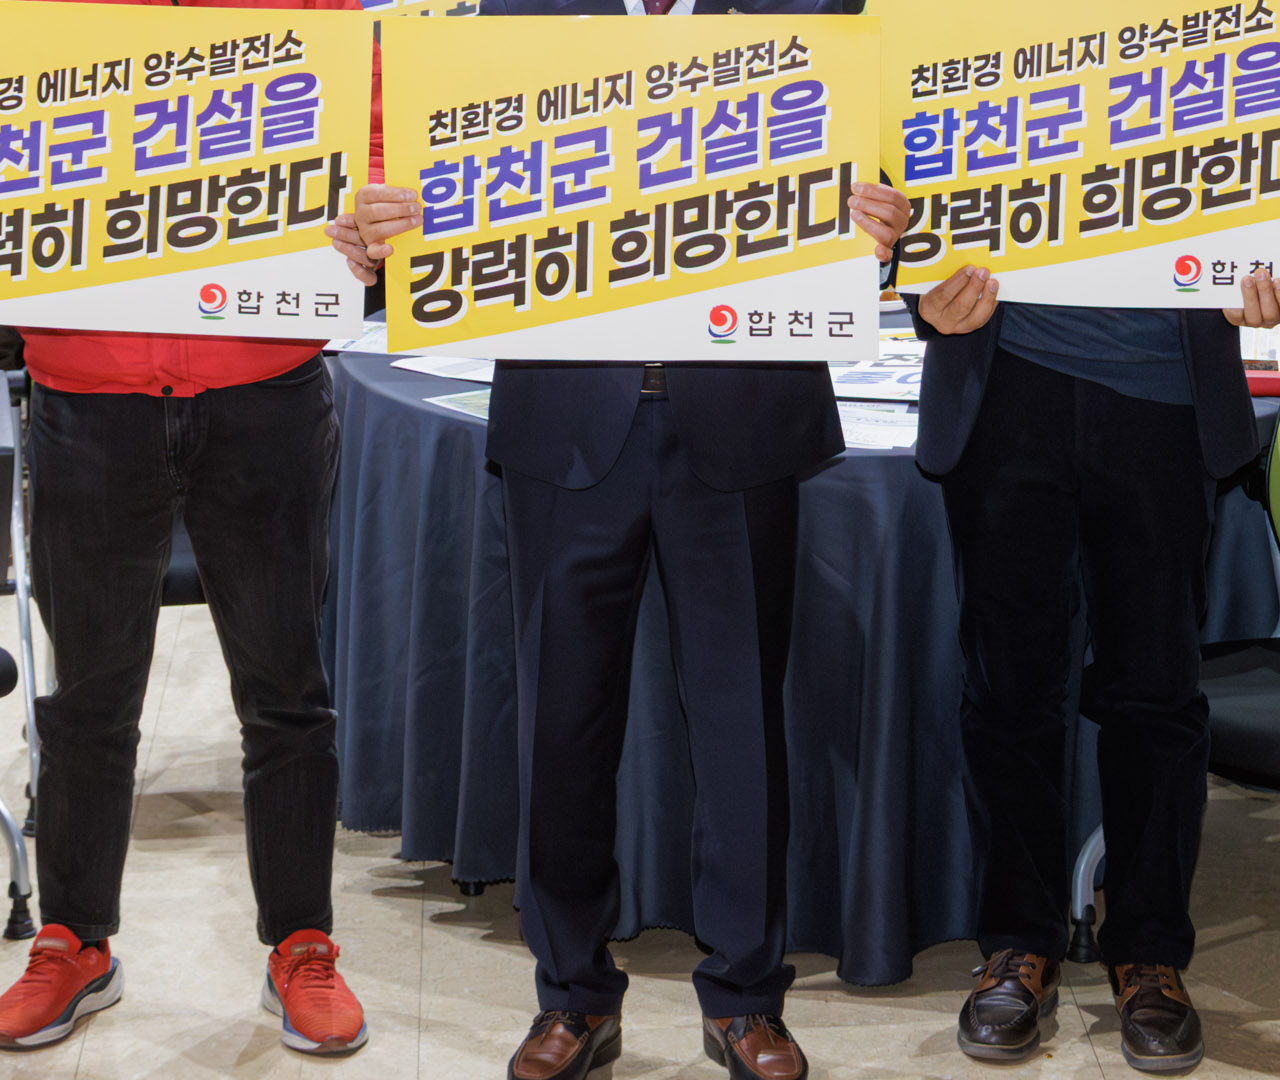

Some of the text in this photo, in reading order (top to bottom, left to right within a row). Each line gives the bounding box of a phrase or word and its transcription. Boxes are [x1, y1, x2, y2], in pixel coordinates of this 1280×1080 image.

[37, 58, 132, 104] 에너지
[143, 30, 305, 88] 양수발전소
[429, 35, 811, 147] 친환경 에너지 양수발전소
[911, 0, 1275, 99] 친환경 에너지 양수발전소
[133, 72, 321, 172] 건설을
[419, 80, 827, 236] 합천군 건설을
[902, 83, 1084, 182] 합천군
[103, 152, 348, 260] 희망한다
[410, 162, 858, 324] 강력히 희망한다
[898, 173, 1062, 264] 강력히
